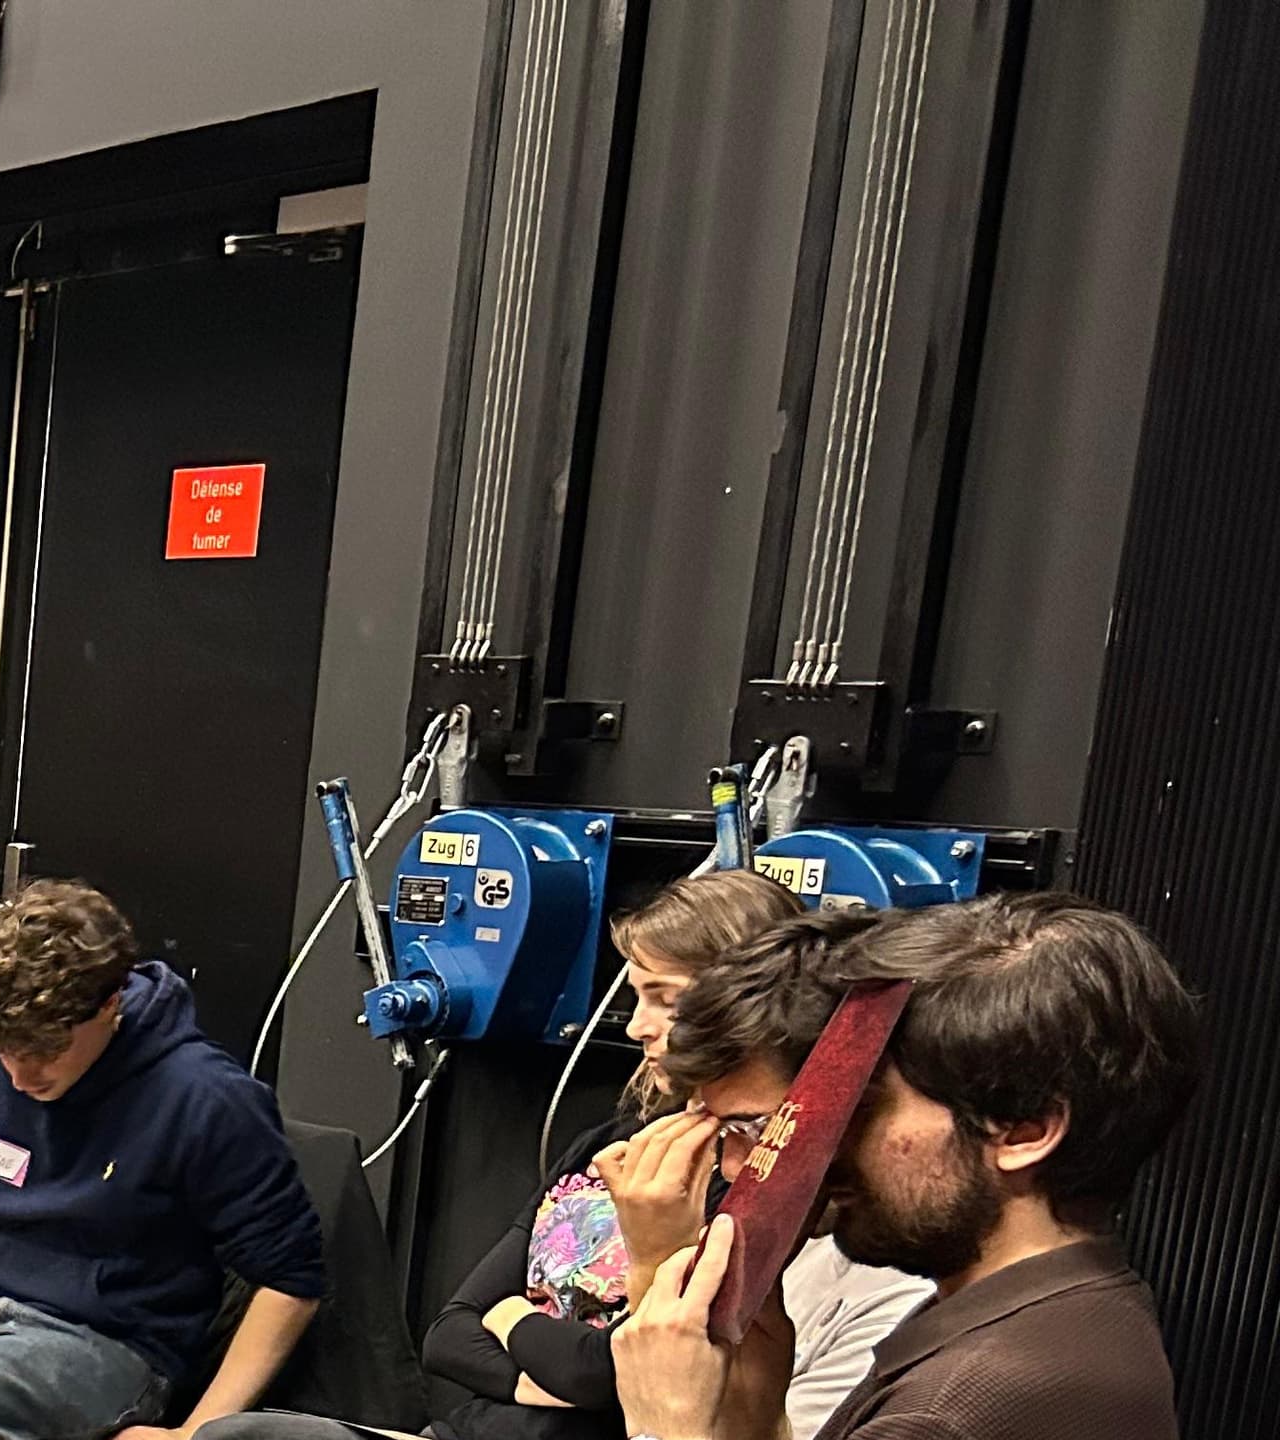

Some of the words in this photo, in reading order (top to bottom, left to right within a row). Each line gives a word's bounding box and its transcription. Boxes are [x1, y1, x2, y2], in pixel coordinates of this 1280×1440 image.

[205, 506, 222, 524] de
[428, 838, 456, 858] Zug
[465, 839, 476, 857] 6
[760, 863, 794, 886] Zug
[806, 868, 820, 888] 5
